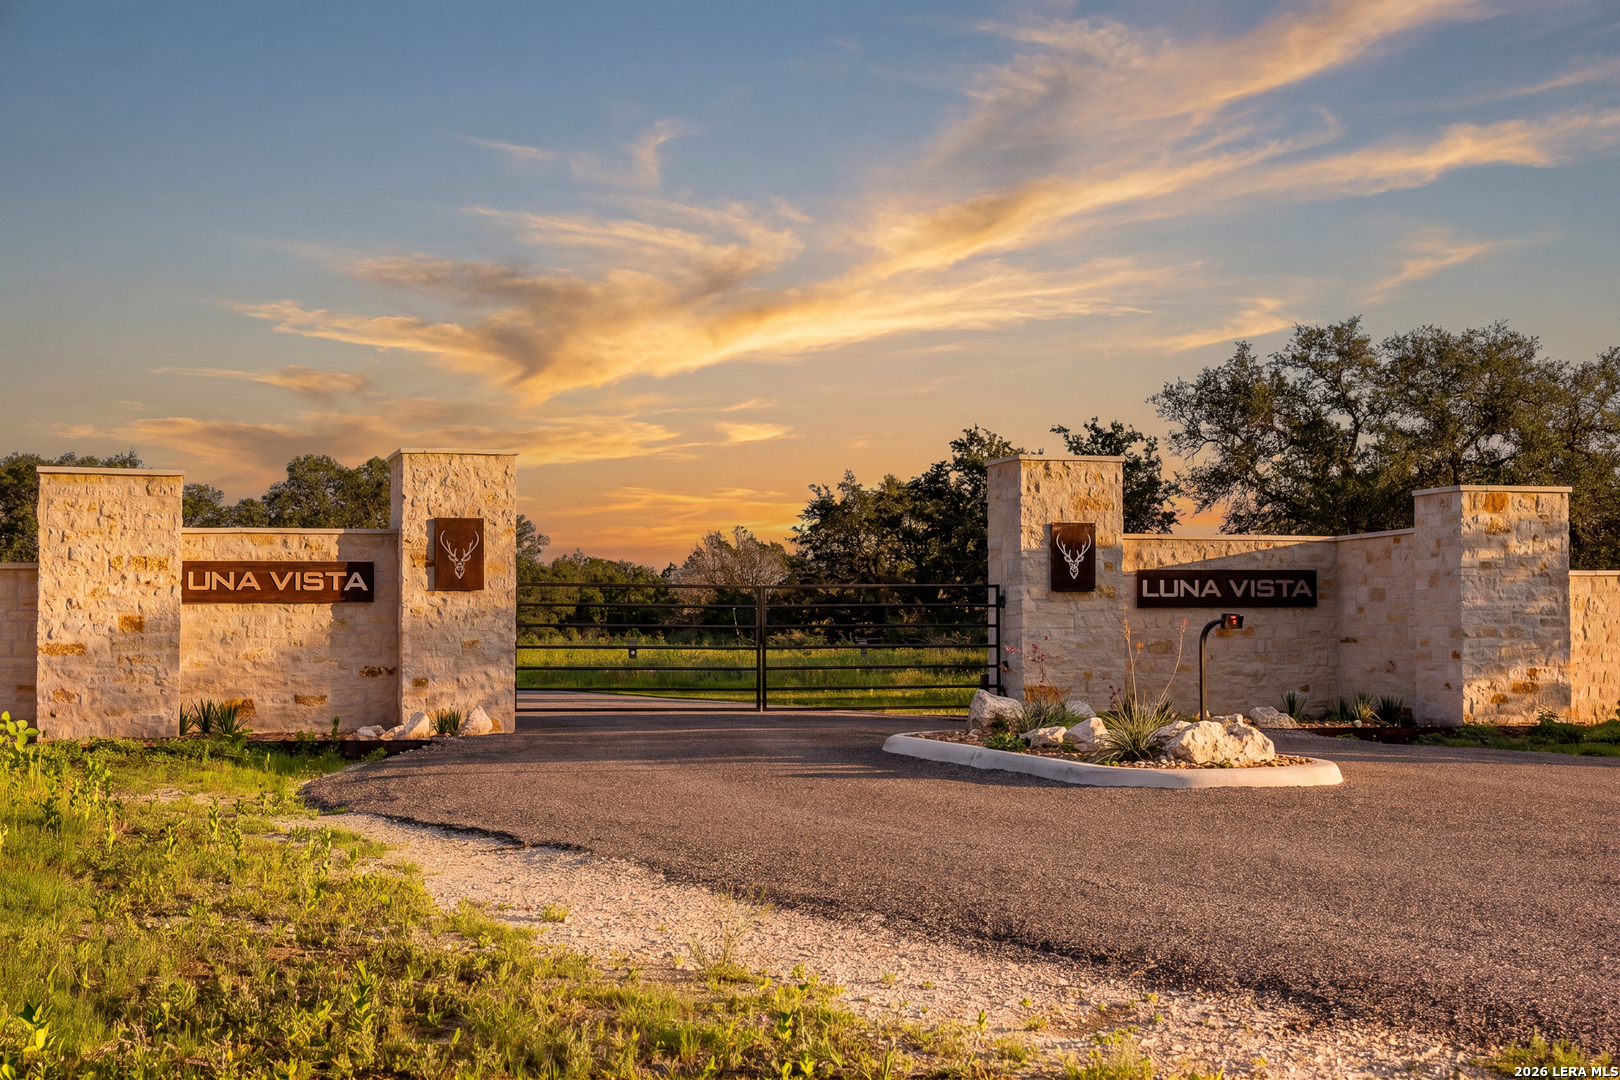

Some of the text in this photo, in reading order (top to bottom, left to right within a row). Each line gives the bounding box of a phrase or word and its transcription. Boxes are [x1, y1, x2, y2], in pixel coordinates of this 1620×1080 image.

[188, 571, 369, 591] UNA VISTA
[1142, 579, 1313, 598] LUNA VISTA
